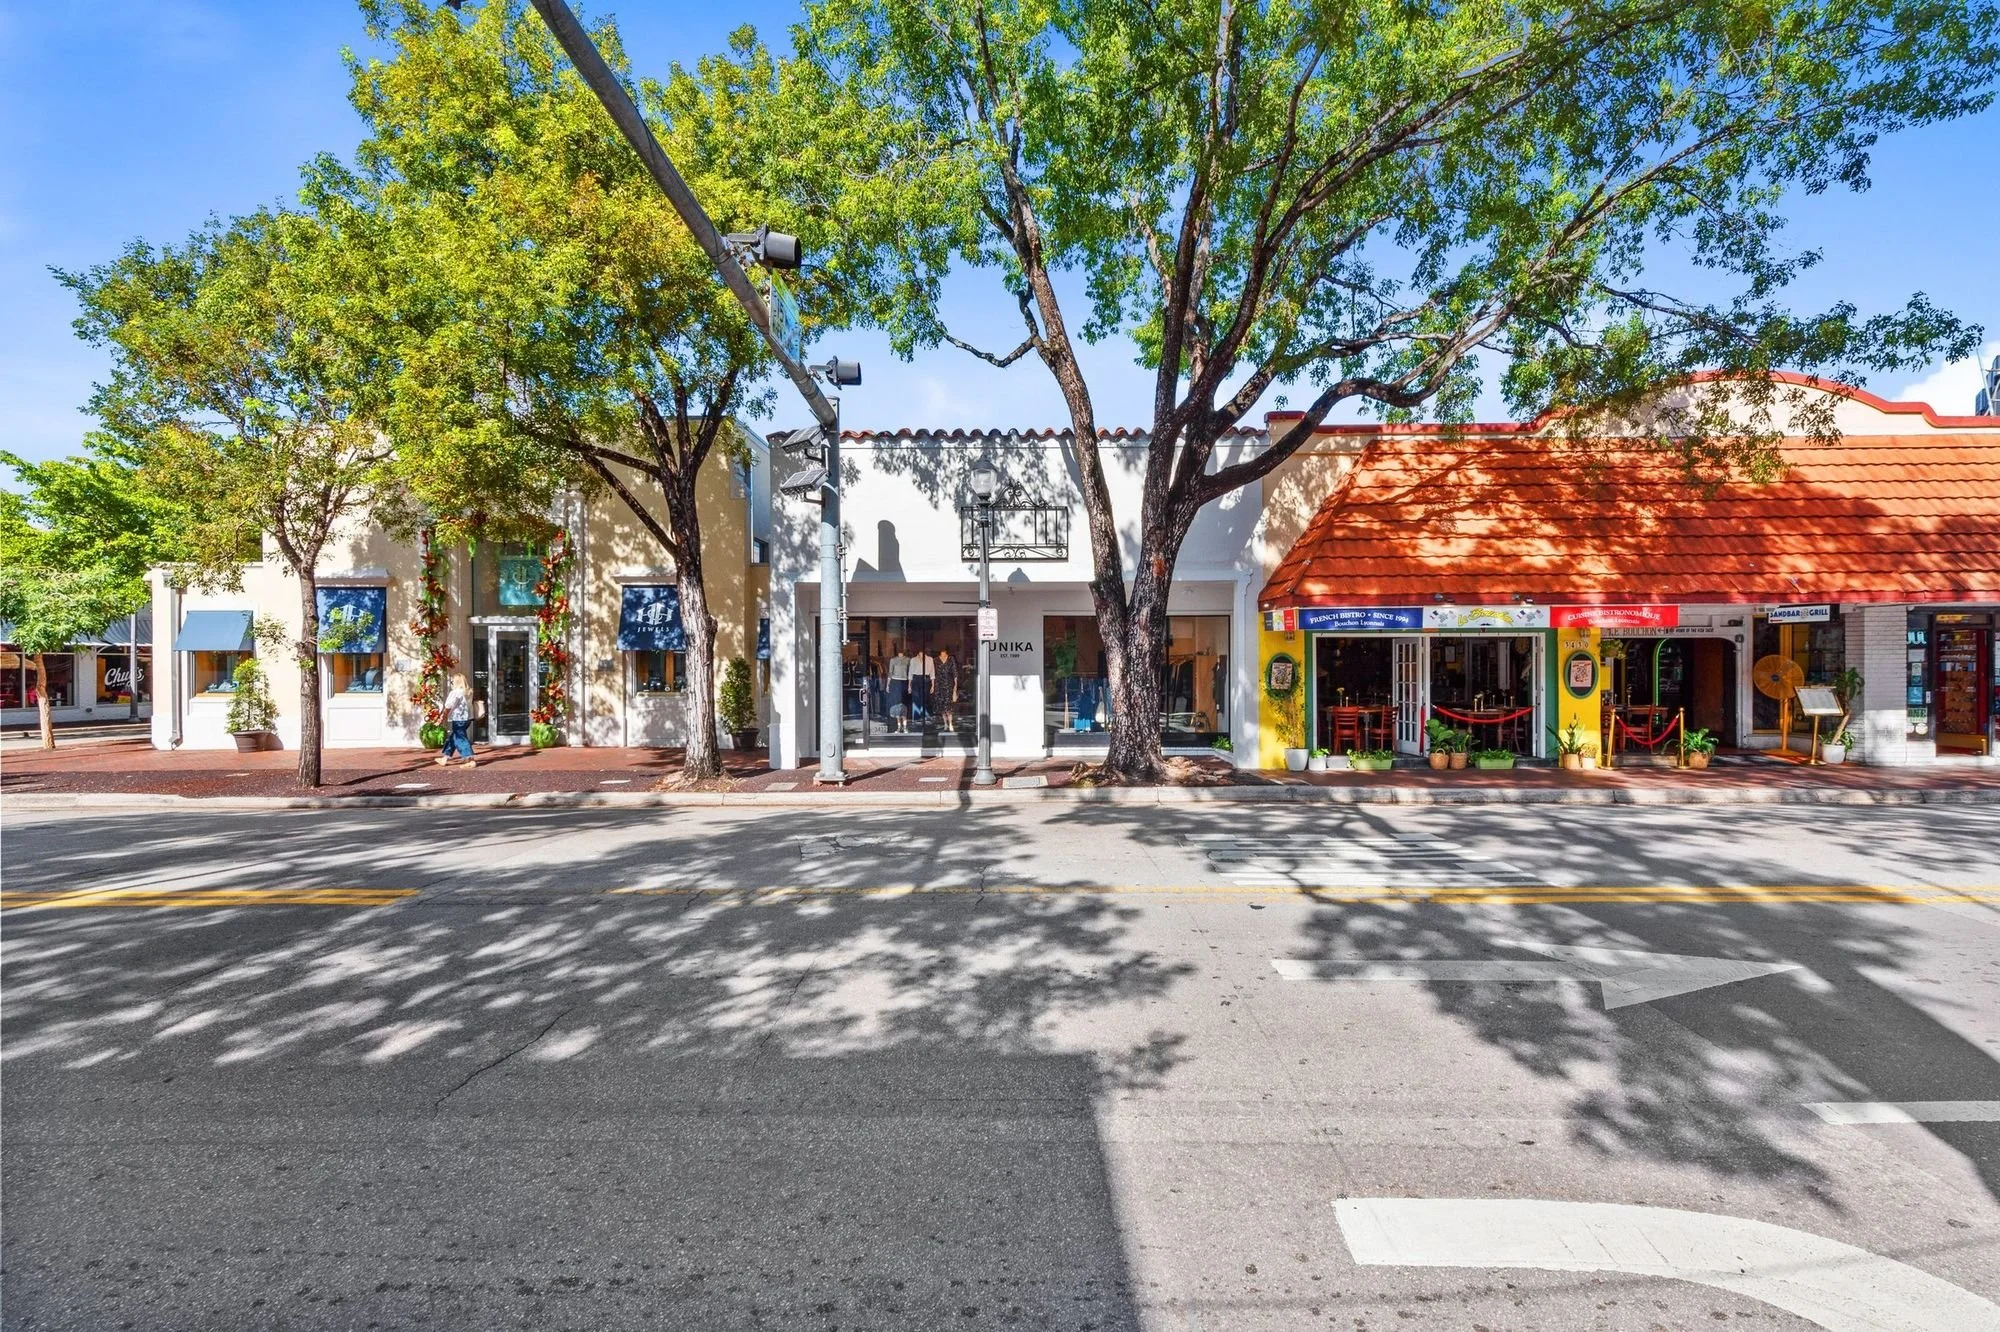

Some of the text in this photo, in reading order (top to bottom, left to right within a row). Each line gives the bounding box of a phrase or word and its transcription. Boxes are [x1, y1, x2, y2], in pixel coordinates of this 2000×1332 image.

[1310, 611, 1409, 624] FRENCH BISTRO SINCE 1994
[1567, 609, 1661, 621] CUISINE BISTRONOMIQUE
[1809, 608, 1829, 616] GRILL
[988, 641, 1034, 652] UNIKA
